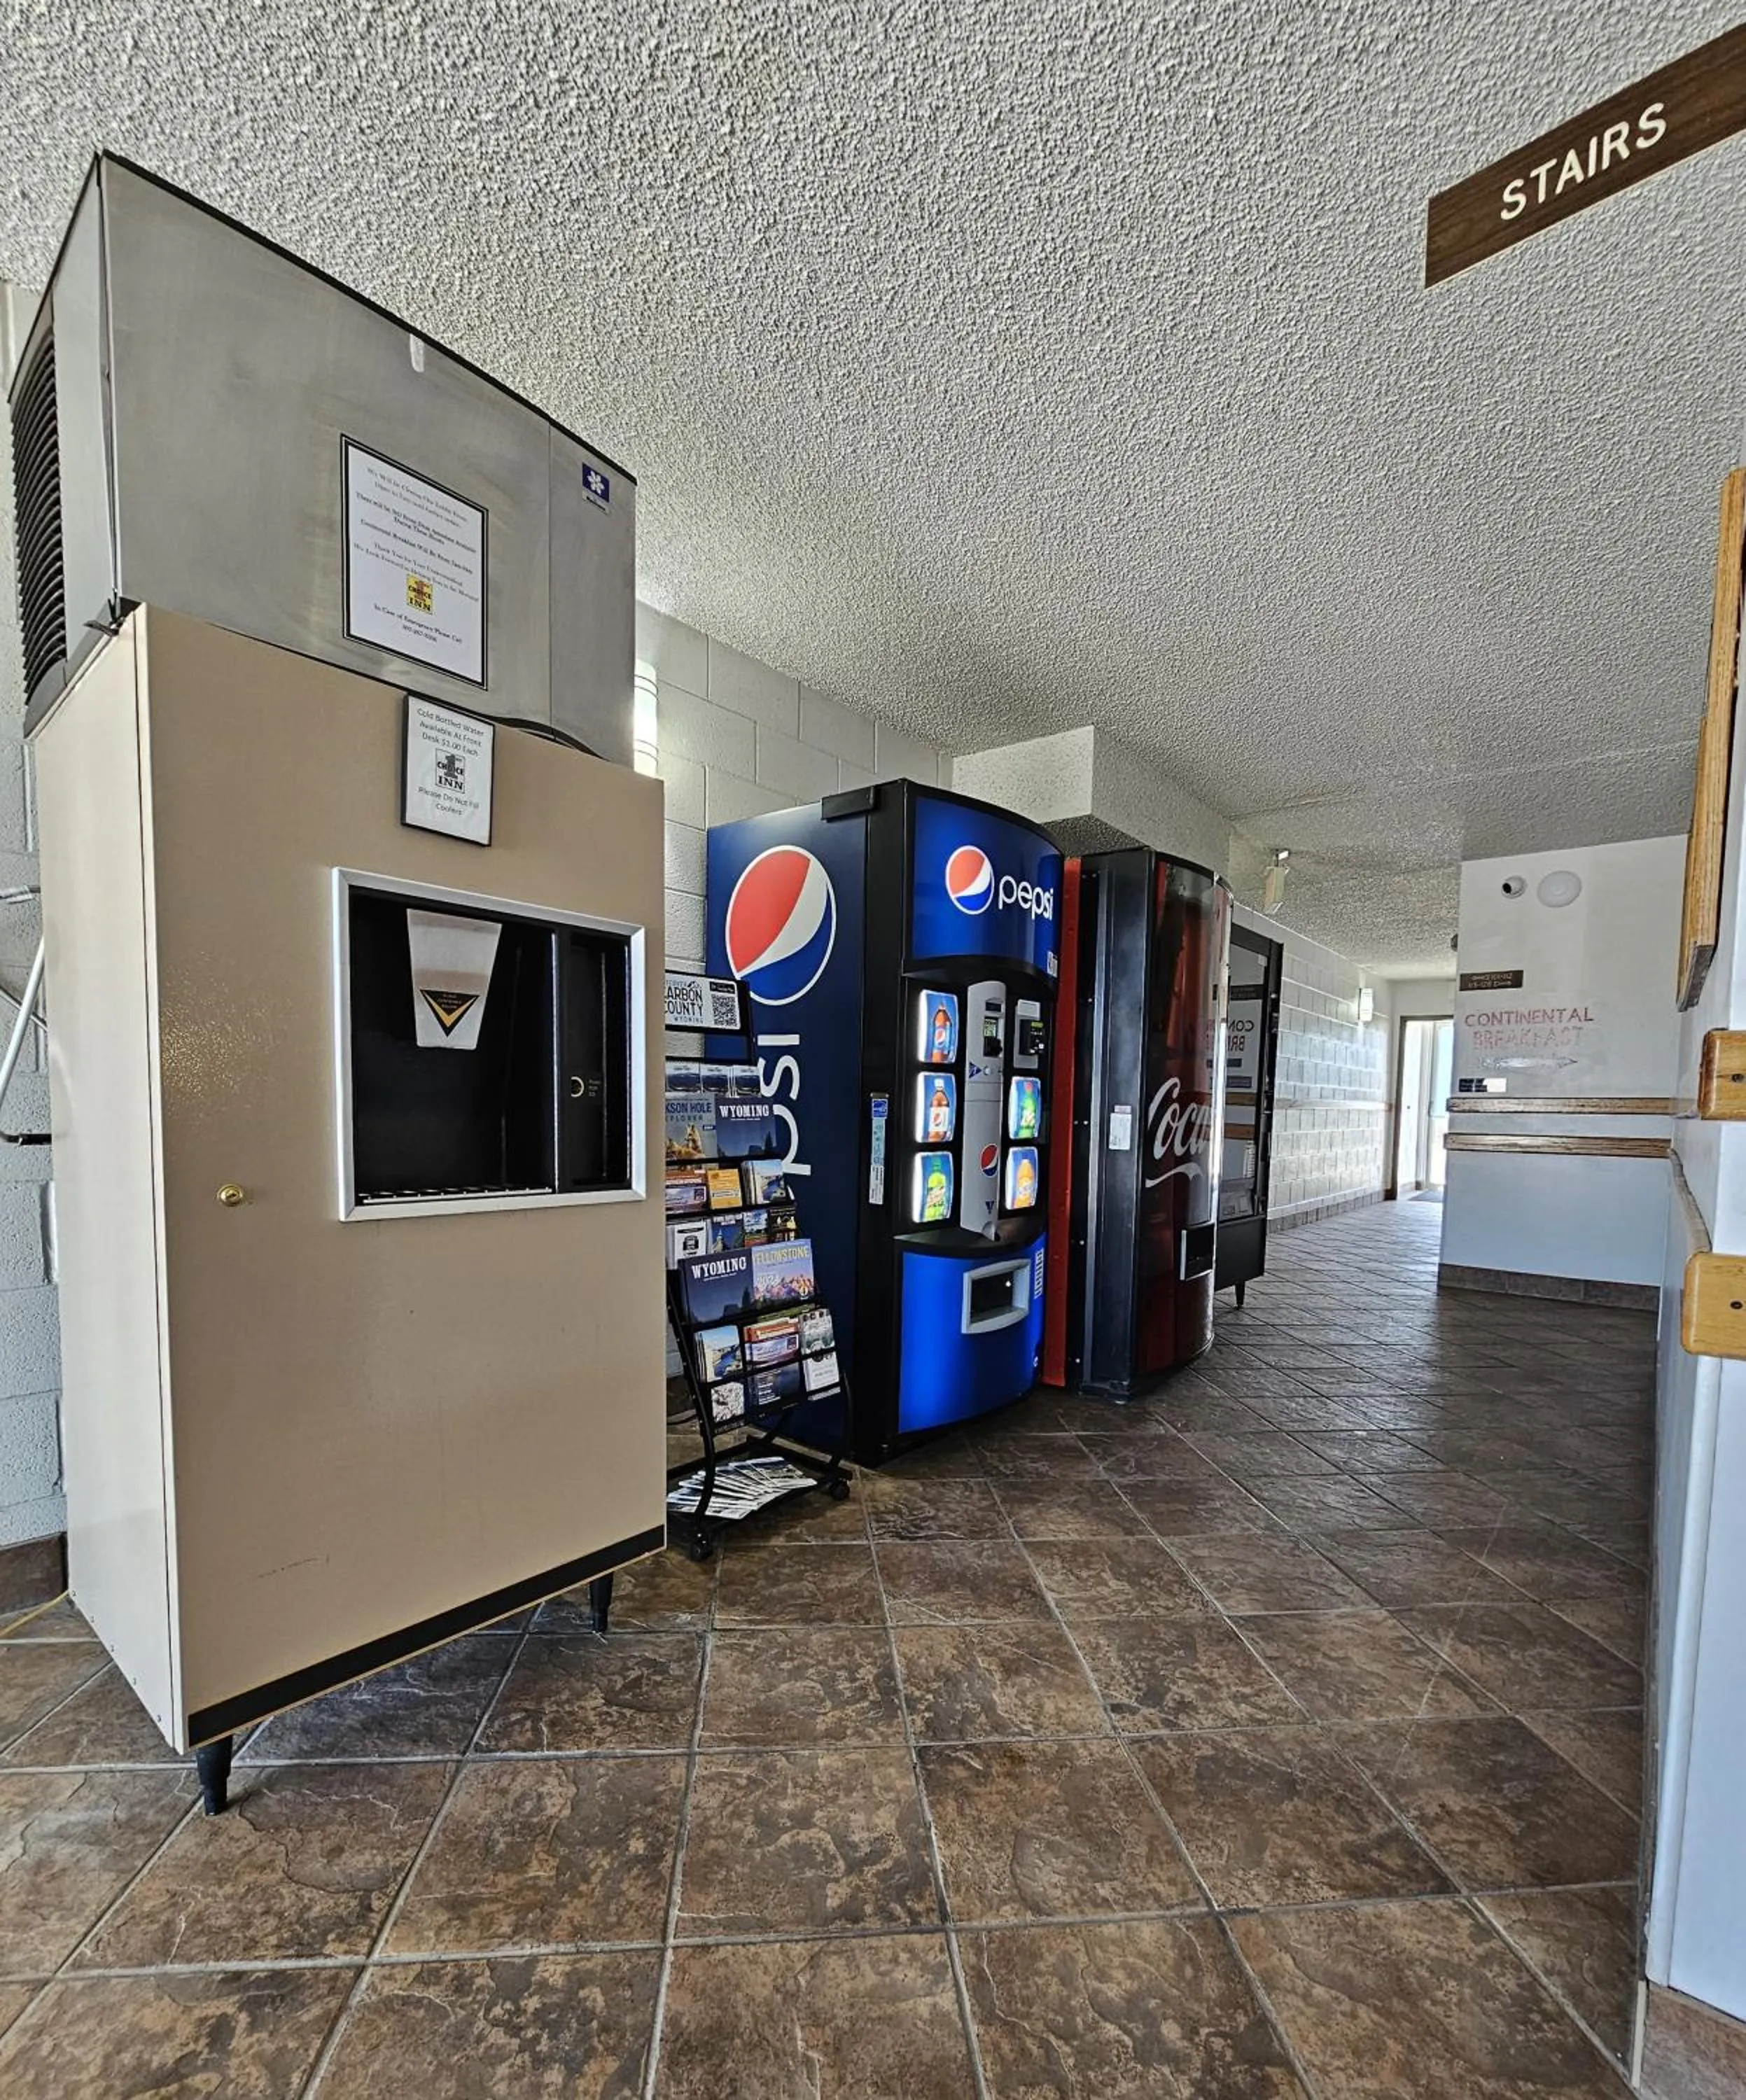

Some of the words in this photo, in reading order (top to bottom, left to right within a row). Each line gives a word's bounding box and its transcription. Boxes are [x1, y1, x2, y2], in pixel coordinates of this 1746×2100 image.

[1500, 102, 1668, 220] STAIRS
[410, 597, 431, 612] INN
[417, 708, 433, 720] Cold
[435, 714, 461, 729] Bottled
[463, 724, 484, 736] Water
[420, 720, 452, 737] Available
[454, 732, 462, 741] At
[463, 734, 482, 747] Front
[422, 732, 440, 744] Desk
[463, 745, 478, 757] Each
[438, 774, 463, 790] INN
[418, 785, 442, 800] Please
[443, 793, 454, 802] Do
[998, 875, 1054, 920] pepsi
[664, 986, 703, 1003] ARBON
[1465, 1007, 1595, 1028] CONTINENTAL
[666, 1102, 688, 1114] KSON
[689, 1102, 712, 1113] HOLE
[719, 1103, 769, 1119] WYOMING
[757, 1034, 811, 1177] psi
[753, 1245, 809, 1265] YELLOWSTONE
[691, 1256, 747, 1280] WYOMING
